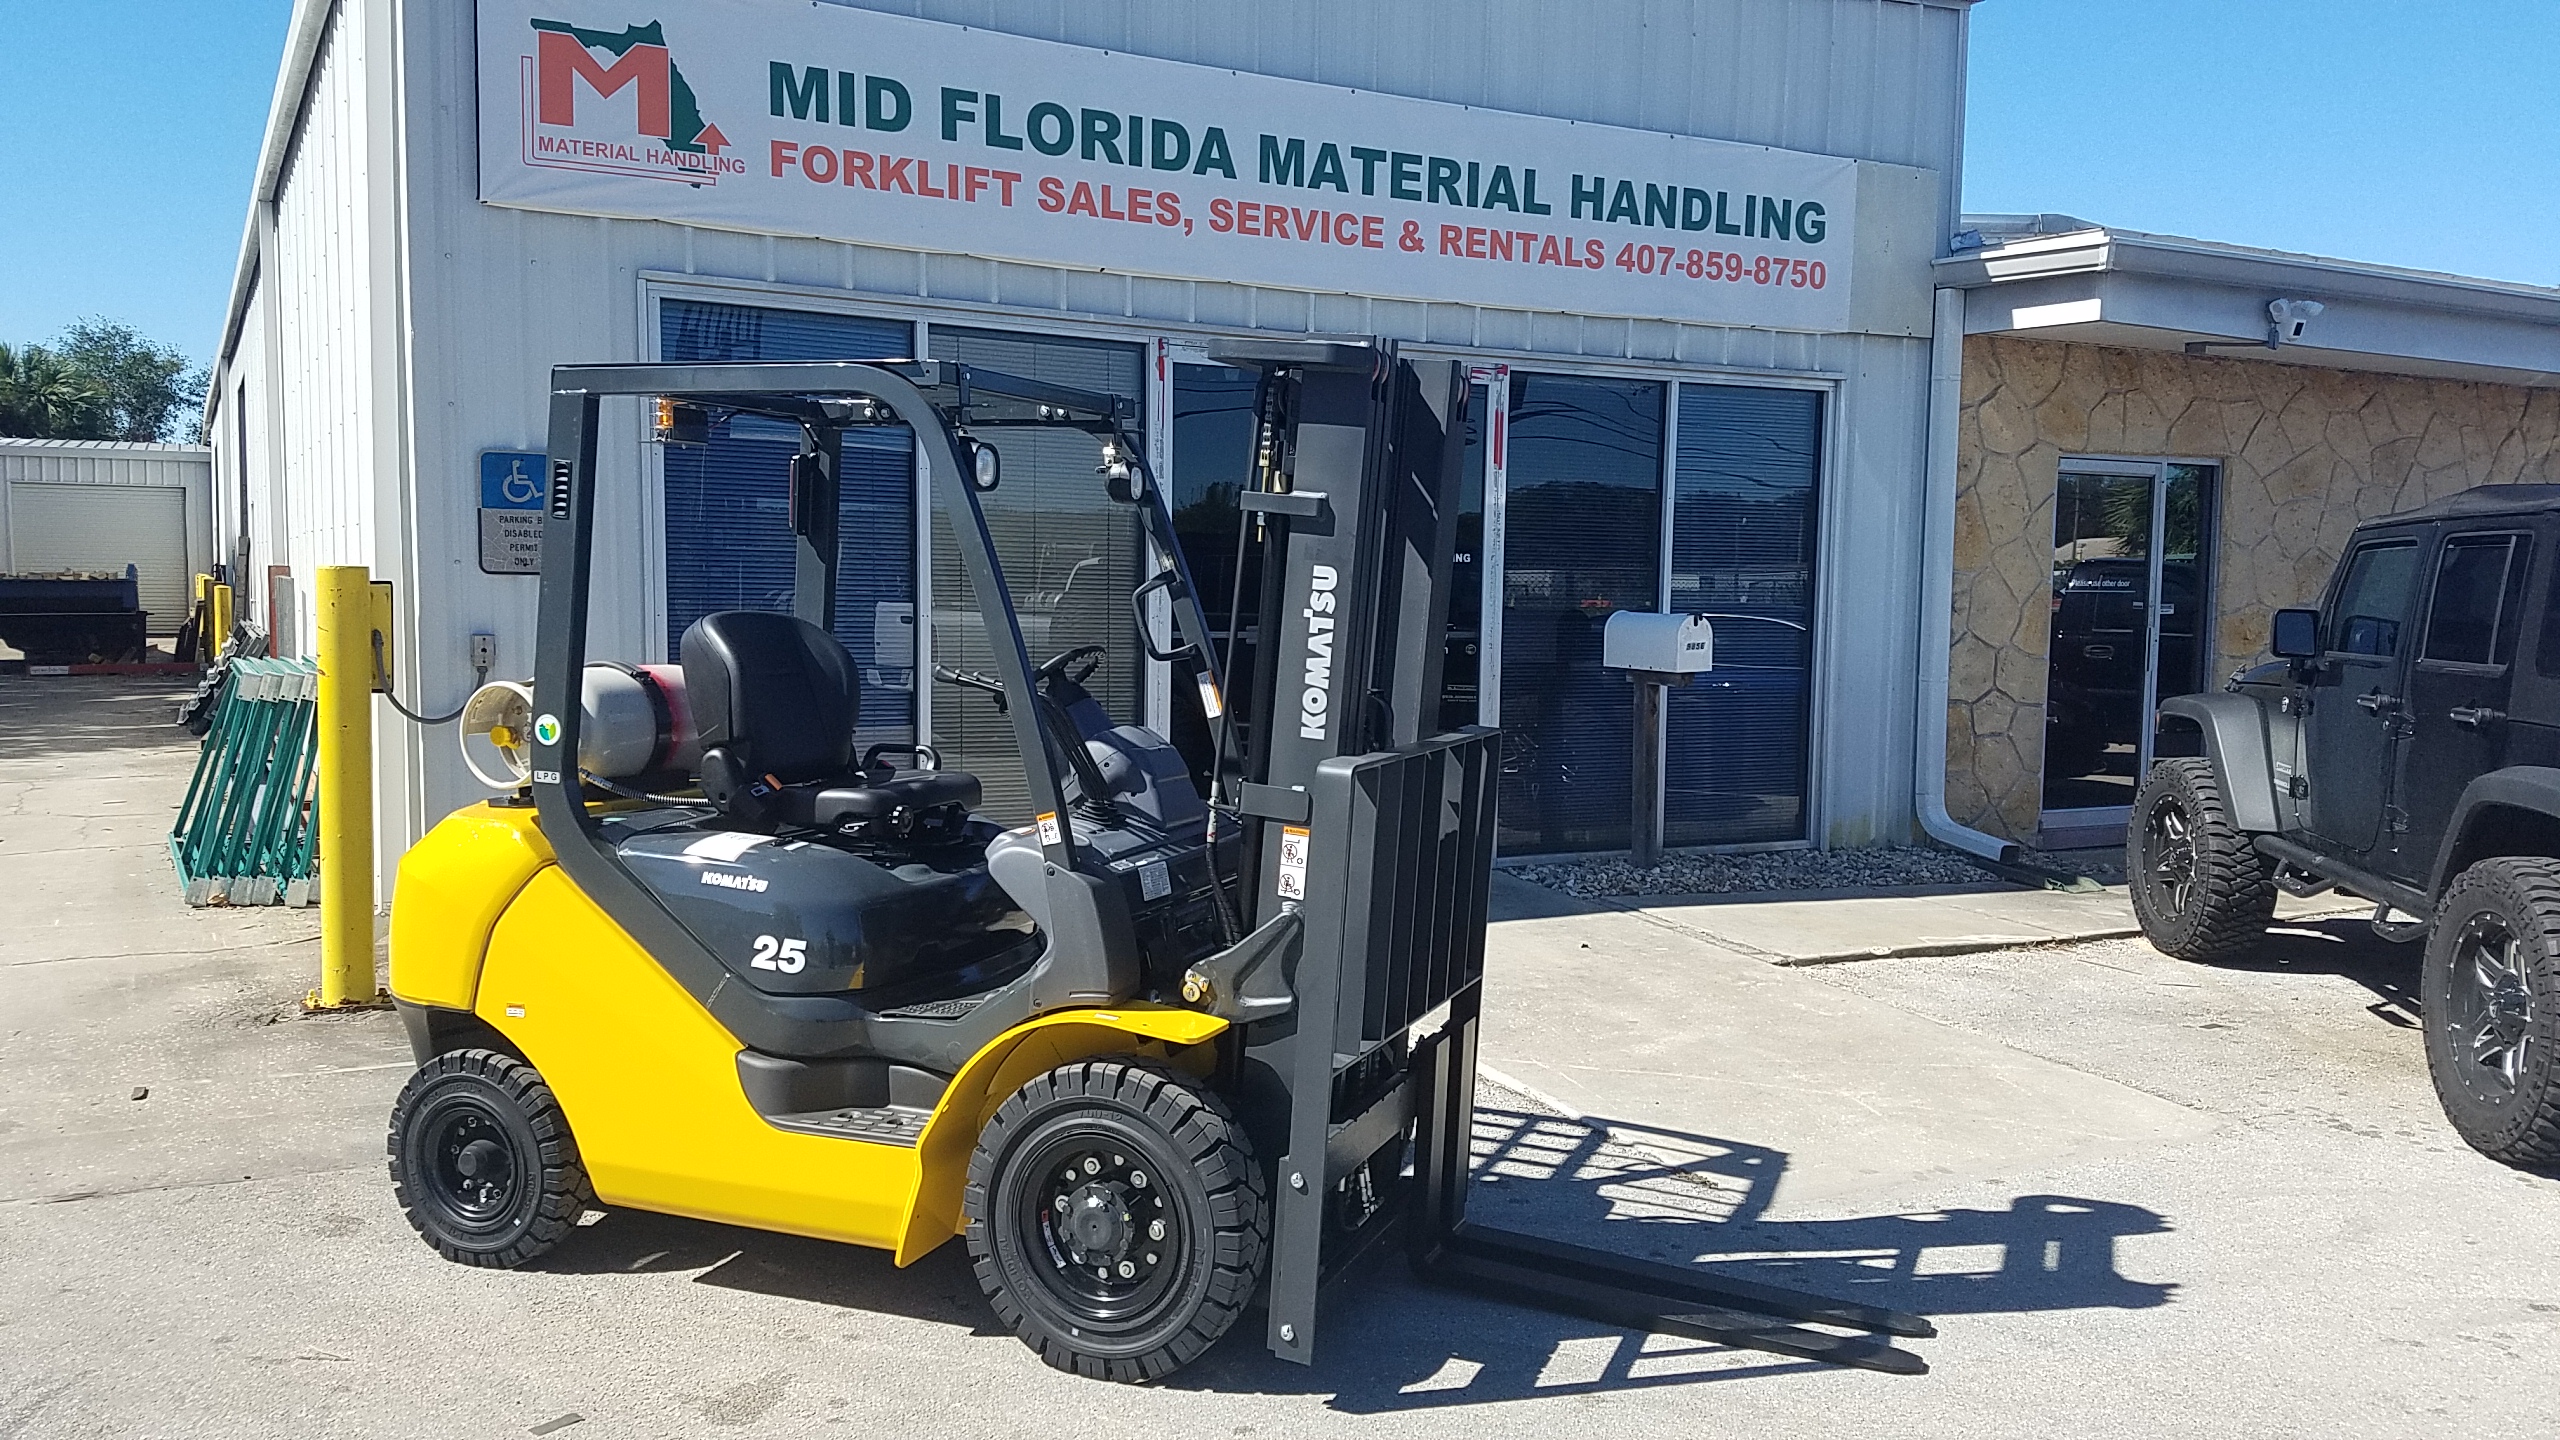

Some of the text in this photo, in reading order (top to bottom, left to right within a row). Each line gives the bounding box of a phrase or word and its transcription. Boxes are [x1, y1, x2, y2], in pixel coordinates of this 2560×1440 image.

[538, 136, 746, 175] MATERIAL HANDLING
[769, 60, 1827, 244] MID FLORIDA MATERIAL HANDLING
[770, 140, 1827, 290] FORKLIFT SALES, SERVICE & RENTALS 407-859-8750
[499, 515, 544, 525] PARKING B
[509, 543, 538, 552] PERMIT
[514, 557, 535, 567] ONLY
[2102, 579, 2116, 587] other
[2117, 579, 2131, 587] door
[1300, 564, 1338, 740] KOMATSU
[701, 871, 769, 893] KOMATSU
[750, 934, 808, 975] 25
